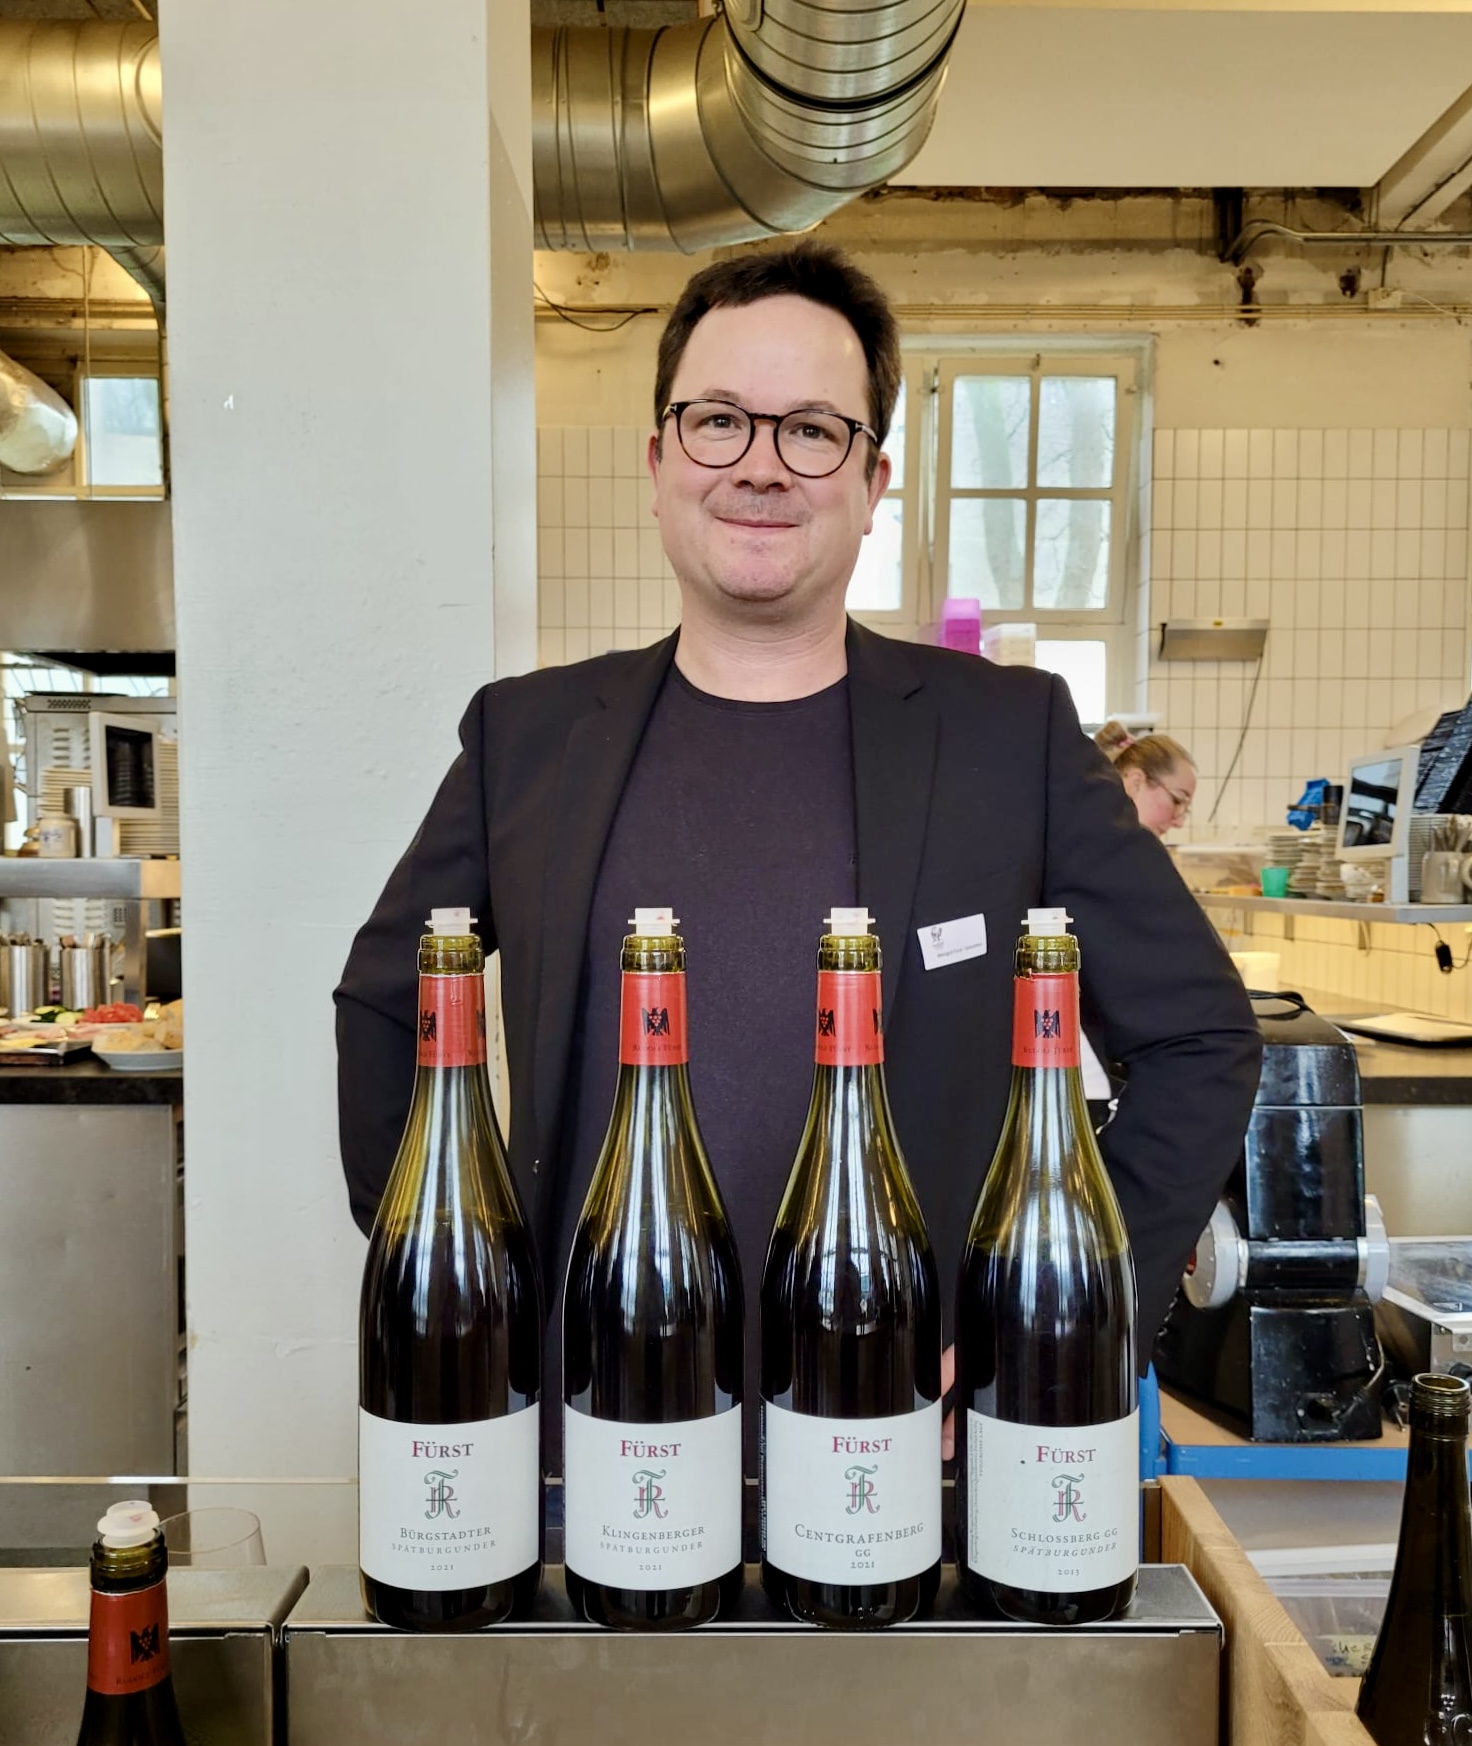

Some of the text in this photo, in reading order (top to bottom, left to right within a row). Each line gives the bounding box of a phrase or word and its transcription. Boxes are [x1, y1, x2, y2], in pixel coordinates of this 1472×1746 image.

[411, 1440, 474, 1459] FÜRST
[620, 1439, 682, 1458] FÜRST
[832, 1436, 893, 1454] FÜRST
[1036, 1445, 1096, 1463] FÜRST
[602, 1525, 705, 1540] KLINGENBERGER
[795, 1522, 924, 1544] CENTGRAFENBERG
[1011, 1527, 1118, 1544] SCHLOSSBERG GG
[855, 1549, 871, 1558] GG
[850, 1561, 875, 1569] 2021
